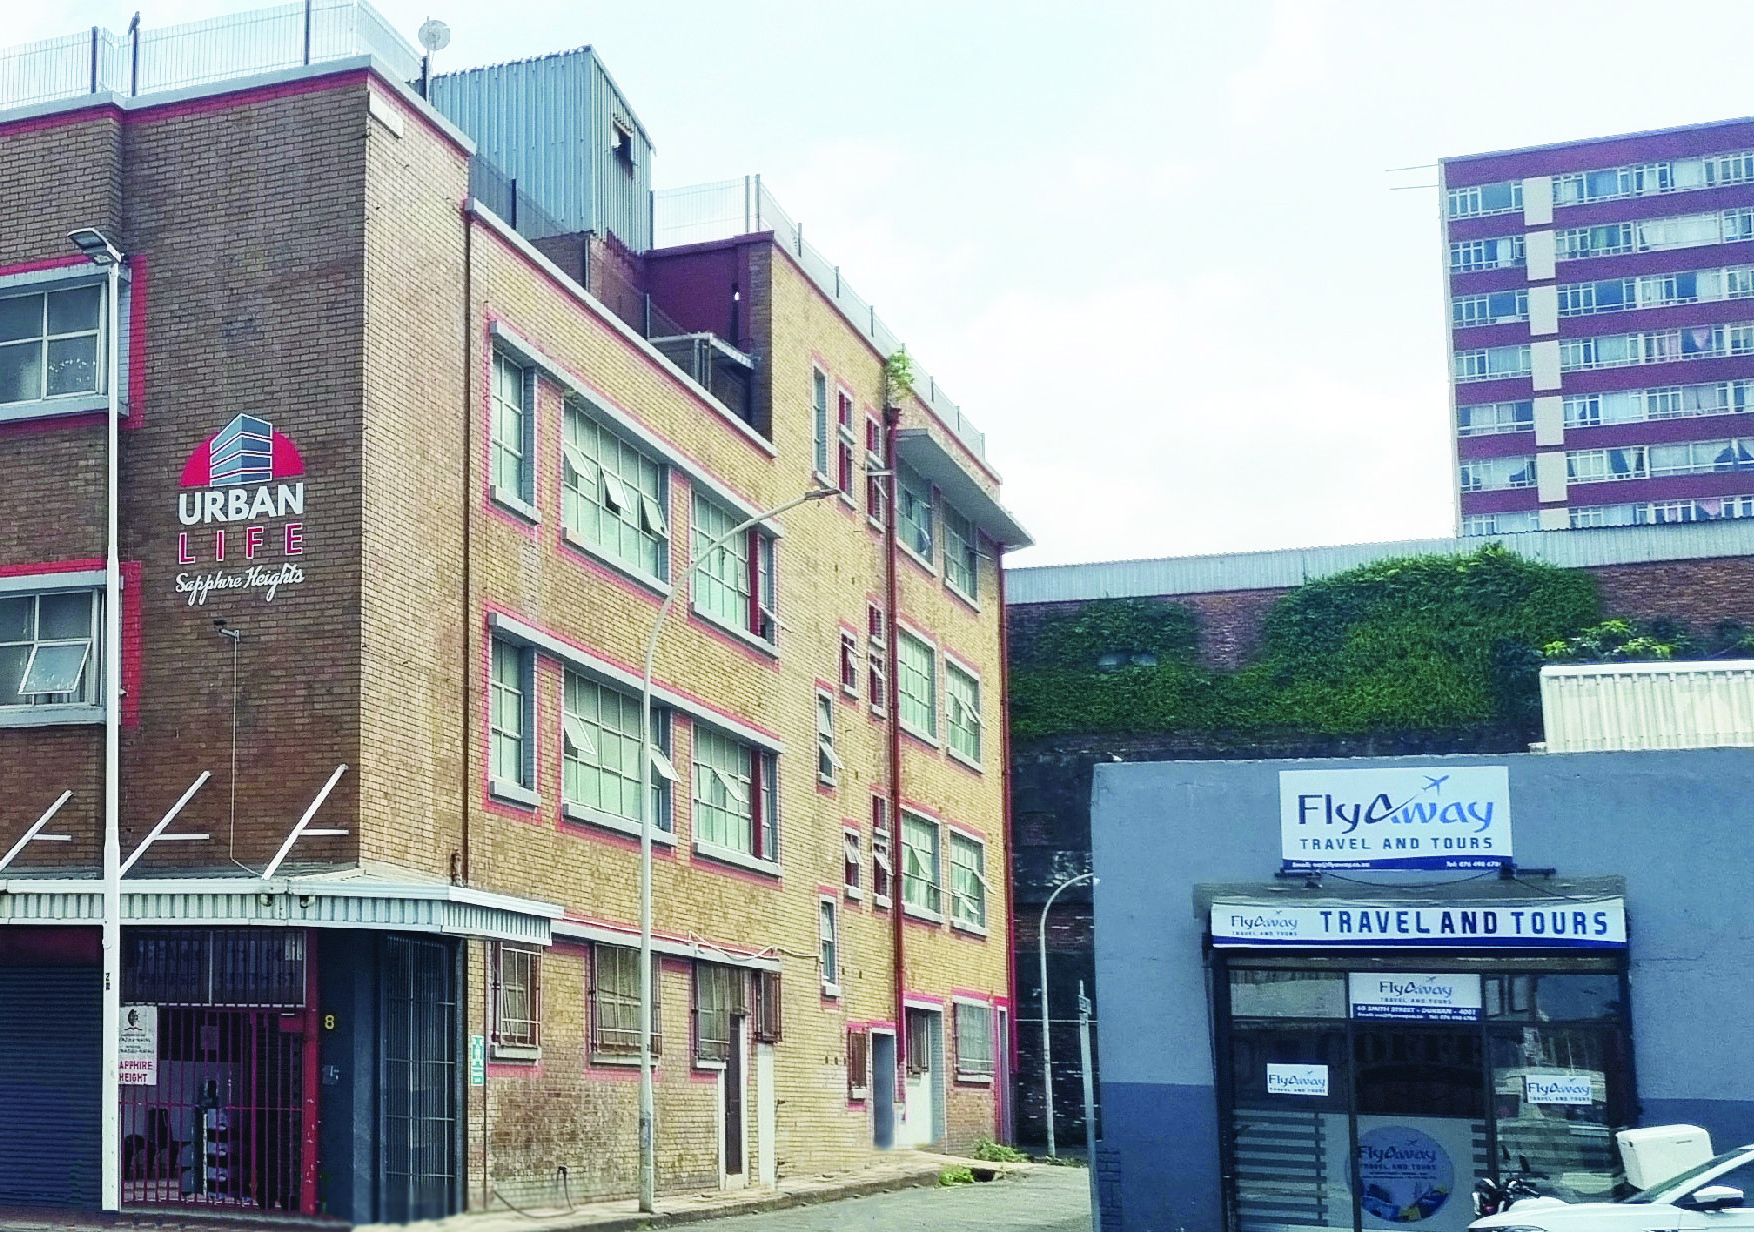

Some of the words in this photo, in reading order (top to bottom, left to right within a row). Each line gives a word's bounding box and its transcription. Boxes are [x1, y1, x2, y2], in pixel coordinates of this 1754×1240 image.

[179, 483, 304, 525] URBAN
[179, 523, 303, 565] LIFE
[175, 571, 243, 607] Sapphire
[243, 563, 305, 603] Heights
[1298, 793, 1494, 835] FlyAway
[1300, 838, 1372, 850] TRAVEL
[1383, 837, 1420, 849] AND
[1431, 837, 1493, 849] TOURS
[1320, 911, 1430, 935] TRAVEL
[1439, 911, 1498, 935] AND
[1510, 911, 1608, 935] TOURS
[324, 1014, 335, 1030] 8
[119, 1061, 153, 1071] APPHIRE
